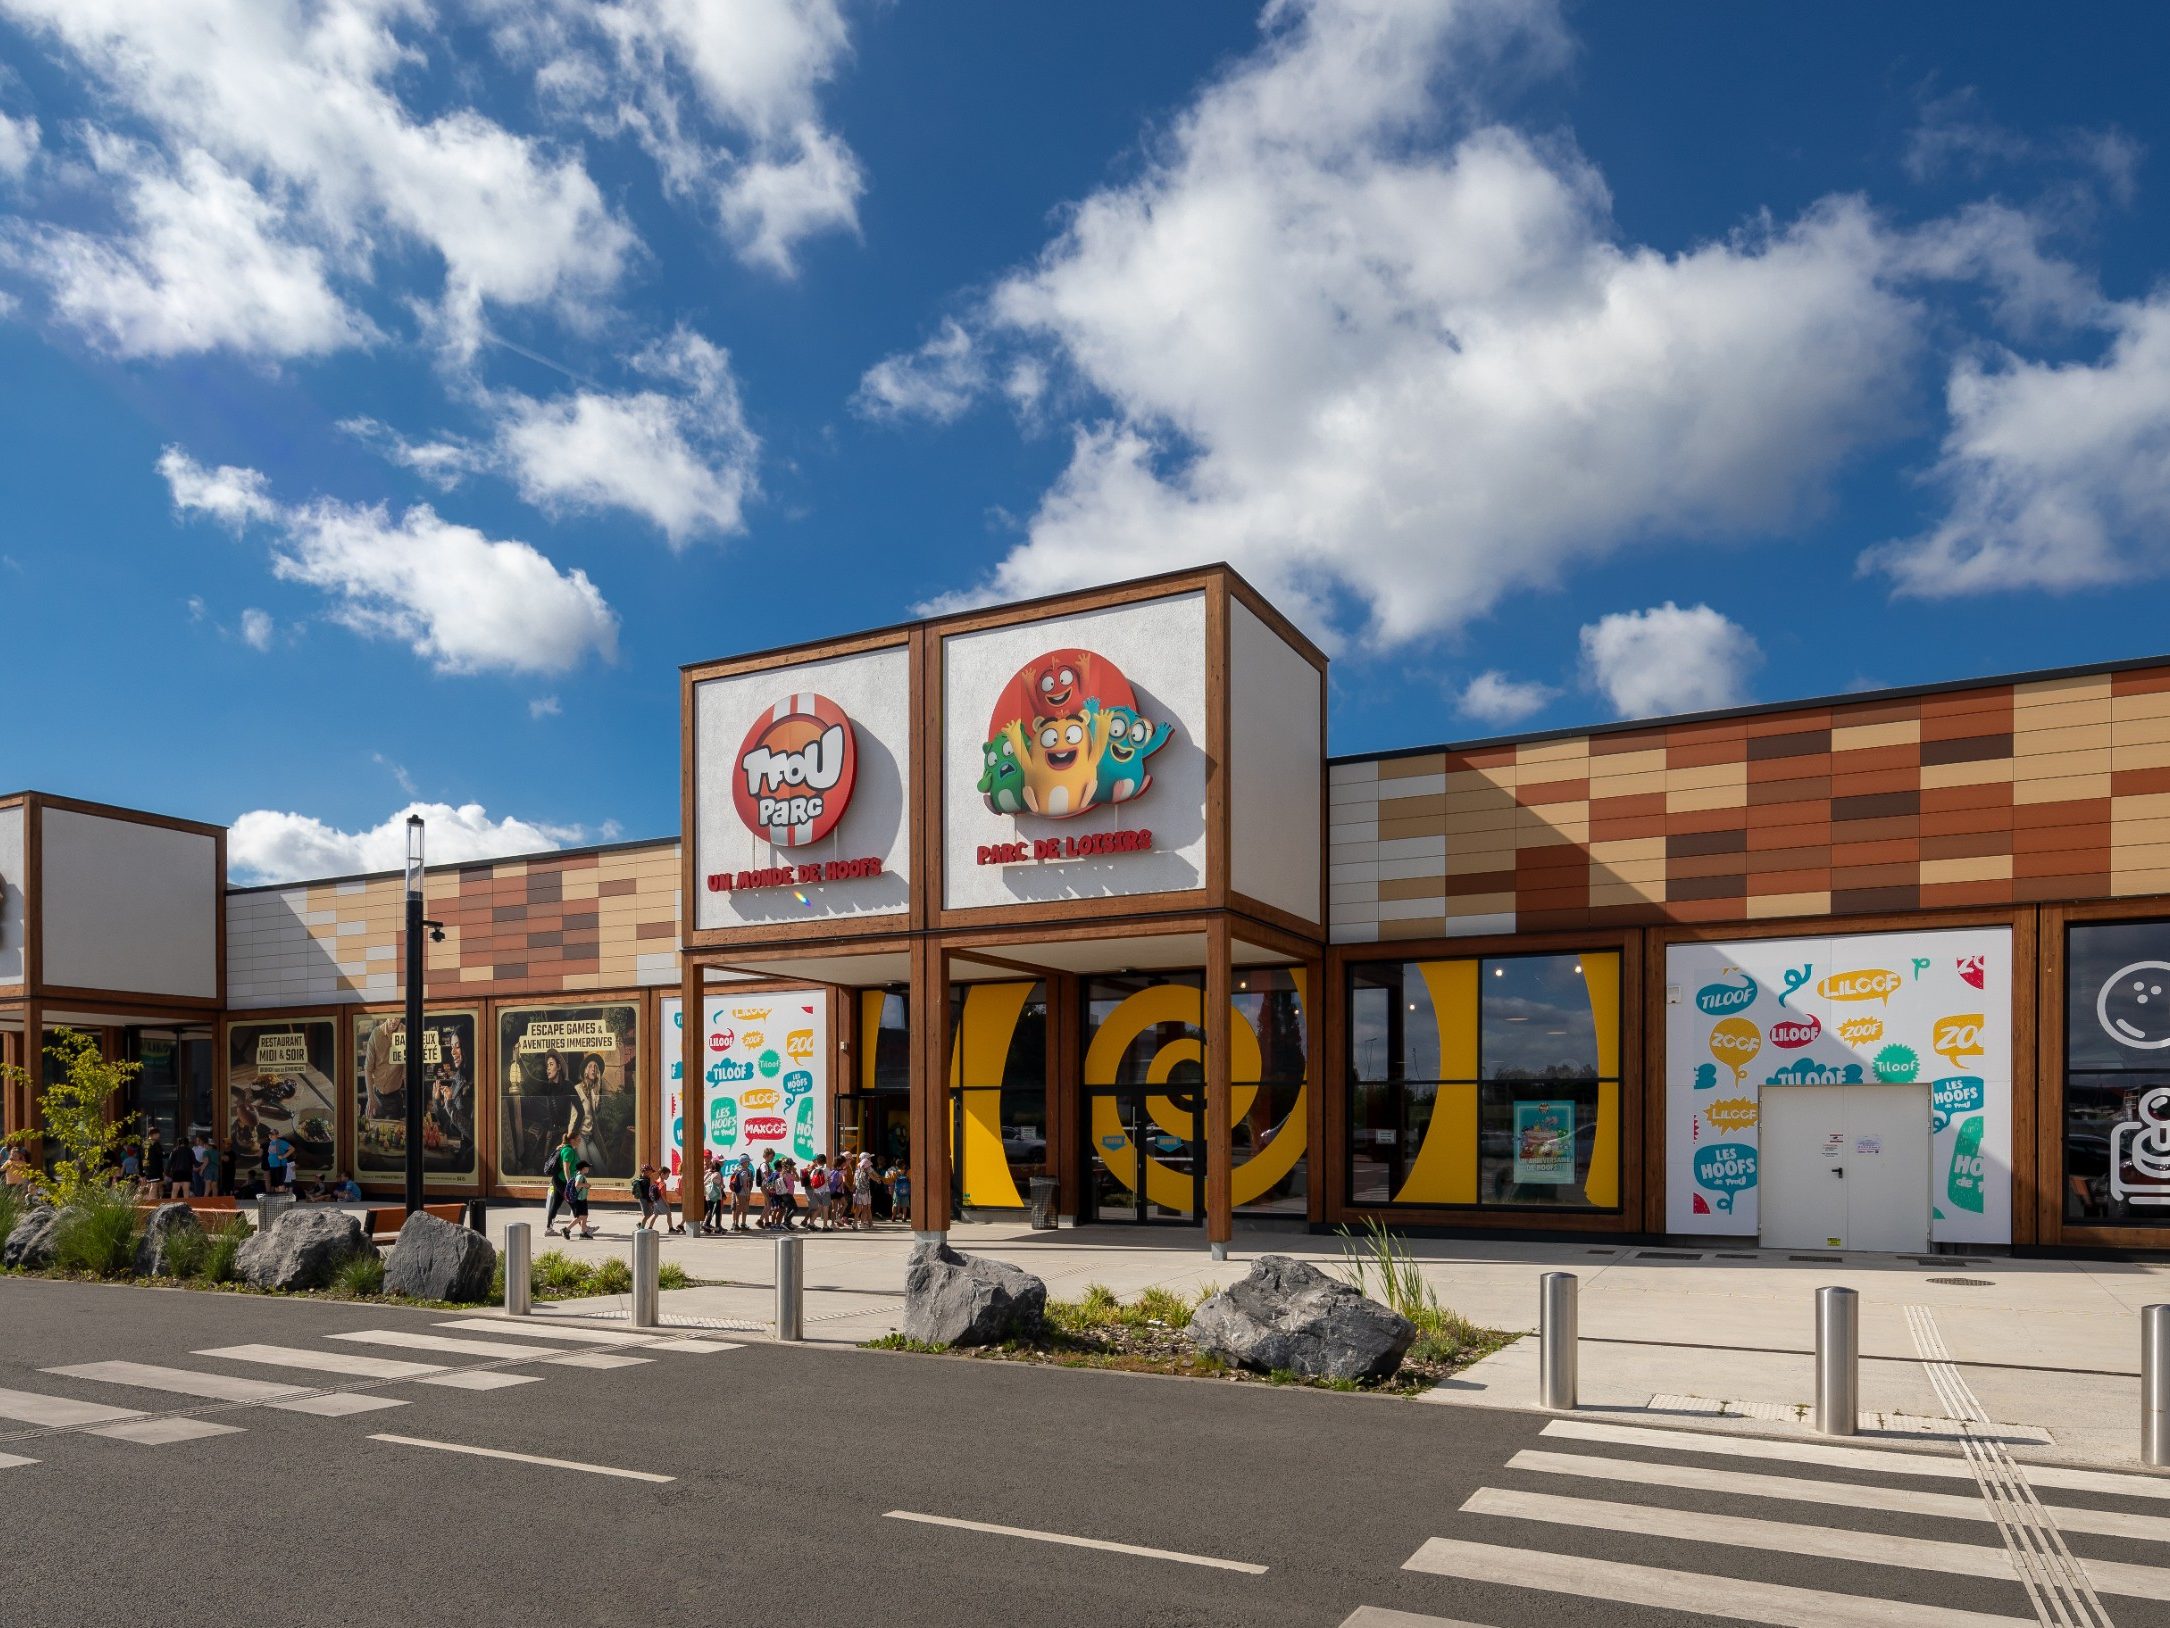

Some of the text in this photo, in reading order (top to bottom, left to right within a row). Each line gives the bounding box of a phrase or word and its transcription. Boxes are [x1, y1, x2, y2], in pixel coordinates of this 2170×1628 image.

[977, 829, 1152, 865] PARC DE LOISIRS
[708, 857, 881, 892] UN MONDE DE HOOFS
[1823, 974, 1898, 997] LILOOF
[1702, 988, 1752, 1009] TILOOF
[531, 1023, 602, 1036] ESCAPE GAMES &
[1771, 1026, 1819, 1042] LILOOF
[1844, 1023, 1880, 1038] ZOOF
[261, 1036, 303, 1048] RESTAURANT
[522, 1037, 612, 1049] AVENTURES IMMERSIVES
[709, 1036, 734, 1047] LILOOF
[1712, 1032, 1760, 1052] ZOOF
[260, 1048, 304, 1061] MIDI & SOIR
[393, 1051, 401, 1061] DE
[713, 1065, 747, 1081] TILOOF
[1946, 1080, 1963, 1090] LES
[742, 1093, 779, 1106] LILOOF
[1934, 1087, 1978, 1104] HOOFS
[716, 1107, 730, 1119] LES
[1712, 1109, 1757, 1119] LILOOF
[712, 1116, 737, 1129] HOOFS
[745, 1122, 787, 1134] MAXOOF
[1715, 1148, 1737, 1160] LES
[1701, 1158, 1756, 1179] HOOFS
